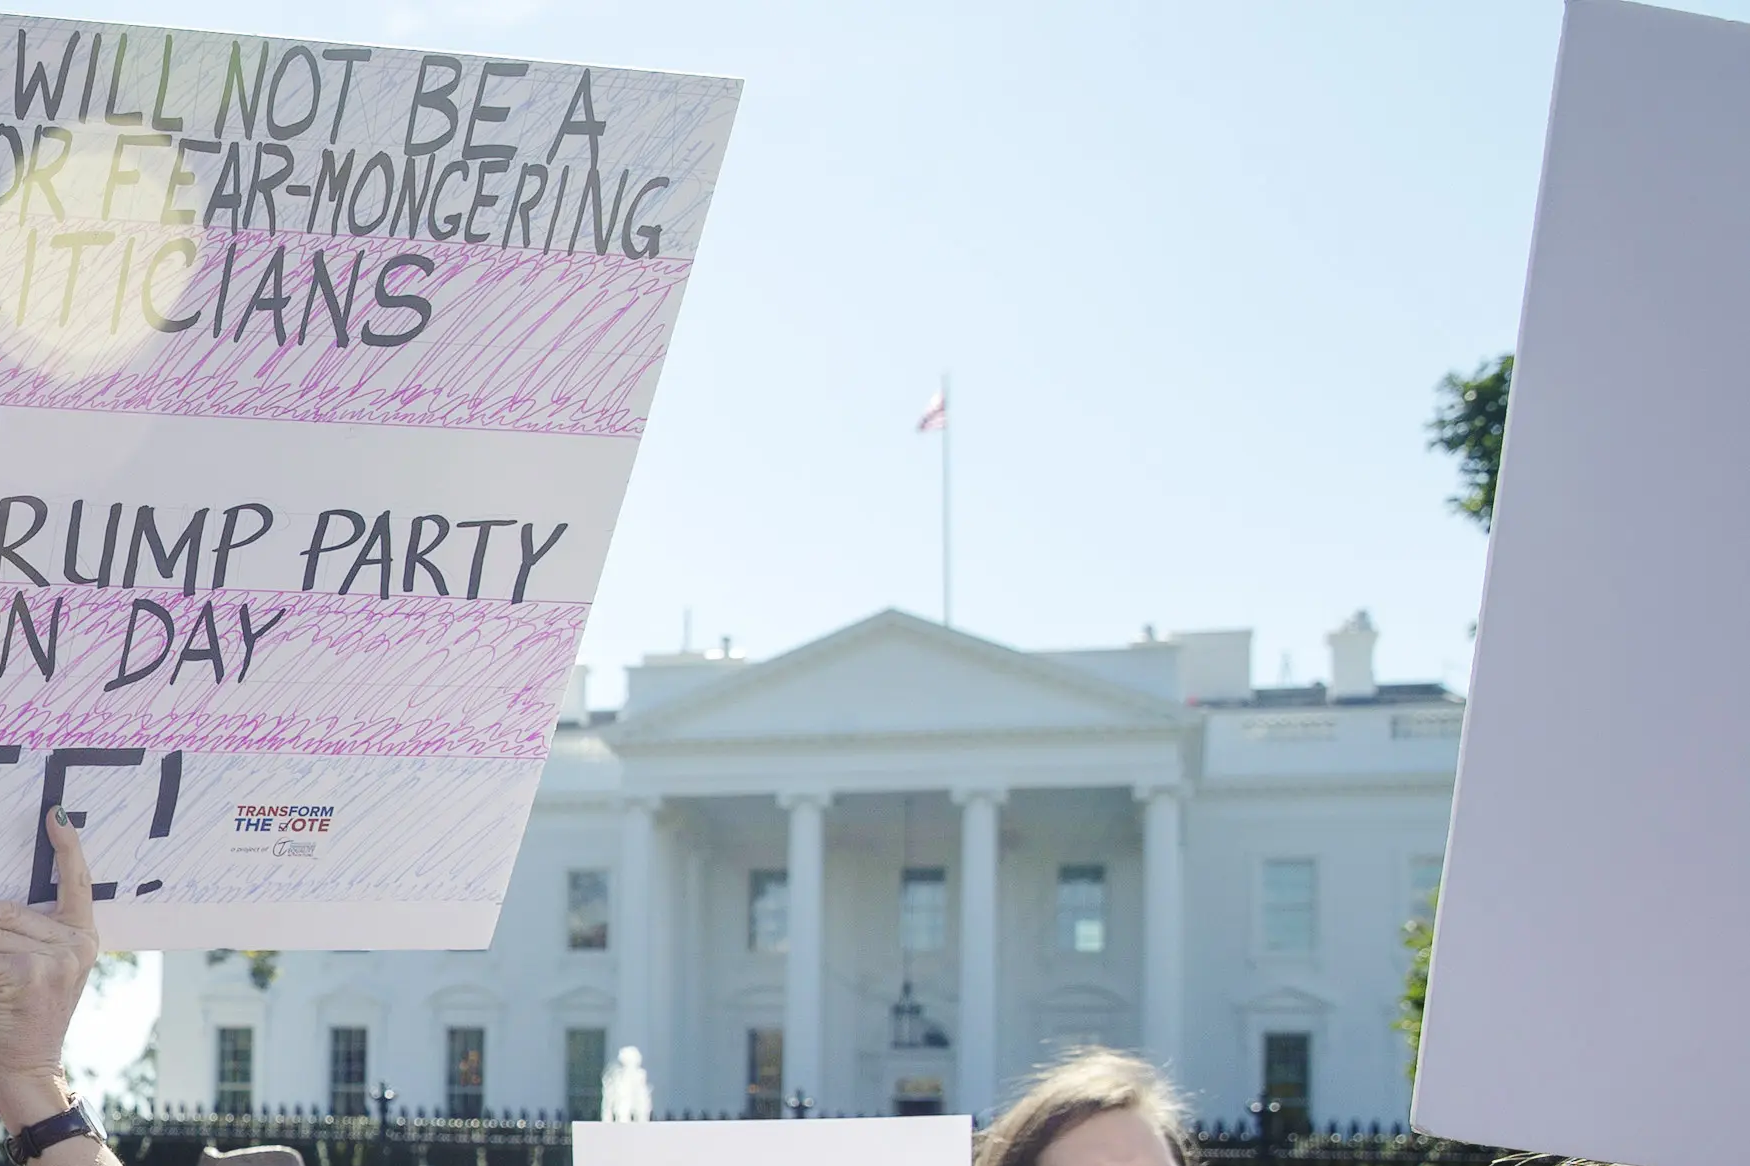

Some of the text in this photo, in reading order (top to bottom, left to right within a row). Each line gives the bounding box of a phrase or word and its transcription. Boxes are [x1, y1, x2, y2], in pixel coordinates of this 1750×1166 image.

[13, 28, 183, 131] WILL
[214, 40, 372, 144] NOT
[404, 54, 528, 161] BE
[548, 68, 607, 169] A
[102, 133, 670, 260] FEAR-MONGERING
[301, 509, 568, 604] PARTY
[103, 597, 286, 693] DAY
[234, 818, 273, 832] THE
[237, 805, 334, 817] TRANSFORM
